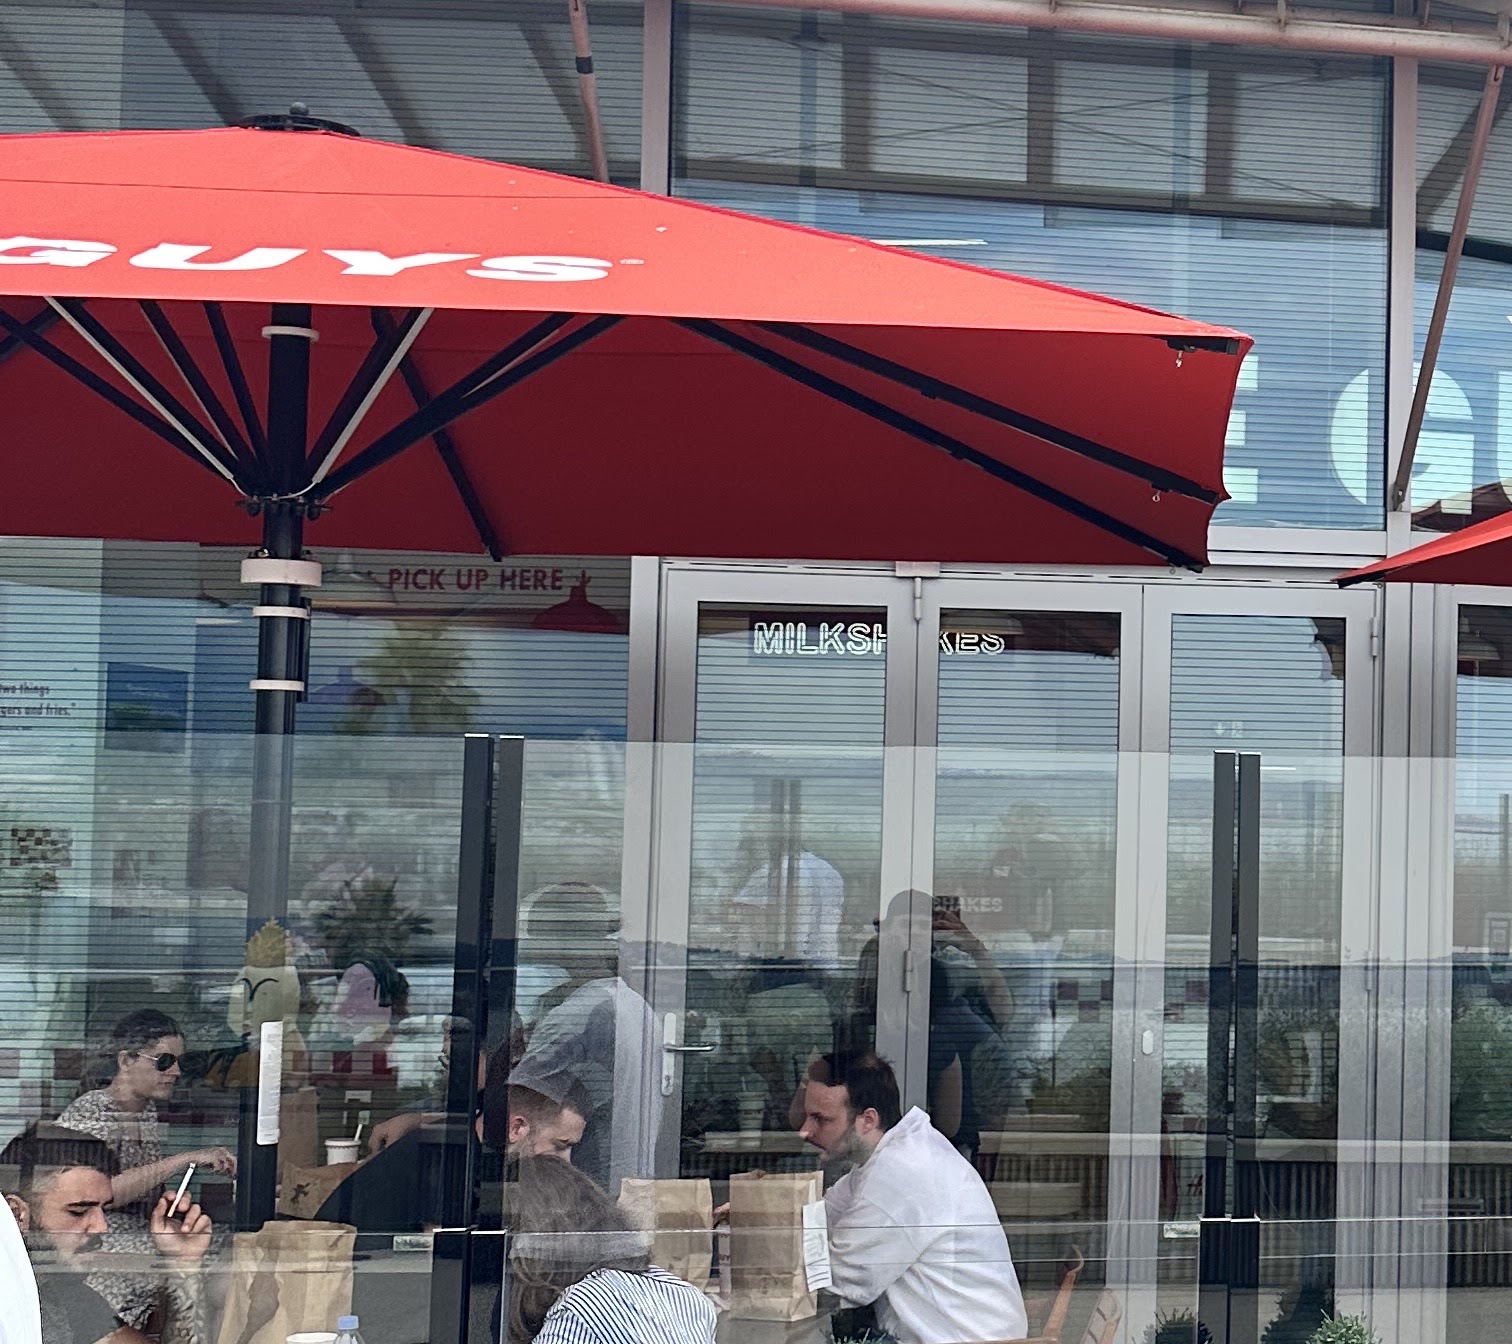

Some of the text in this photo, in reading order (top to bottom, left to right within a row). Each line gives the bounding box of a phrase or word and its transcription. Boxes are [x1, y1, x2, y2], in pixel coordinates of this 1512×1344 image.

[0, 236, 613, 282] GUYS
[389, 568, 563, 591] PICK UP HERE
[754, 622, 1004, 655] MILKSHKES
